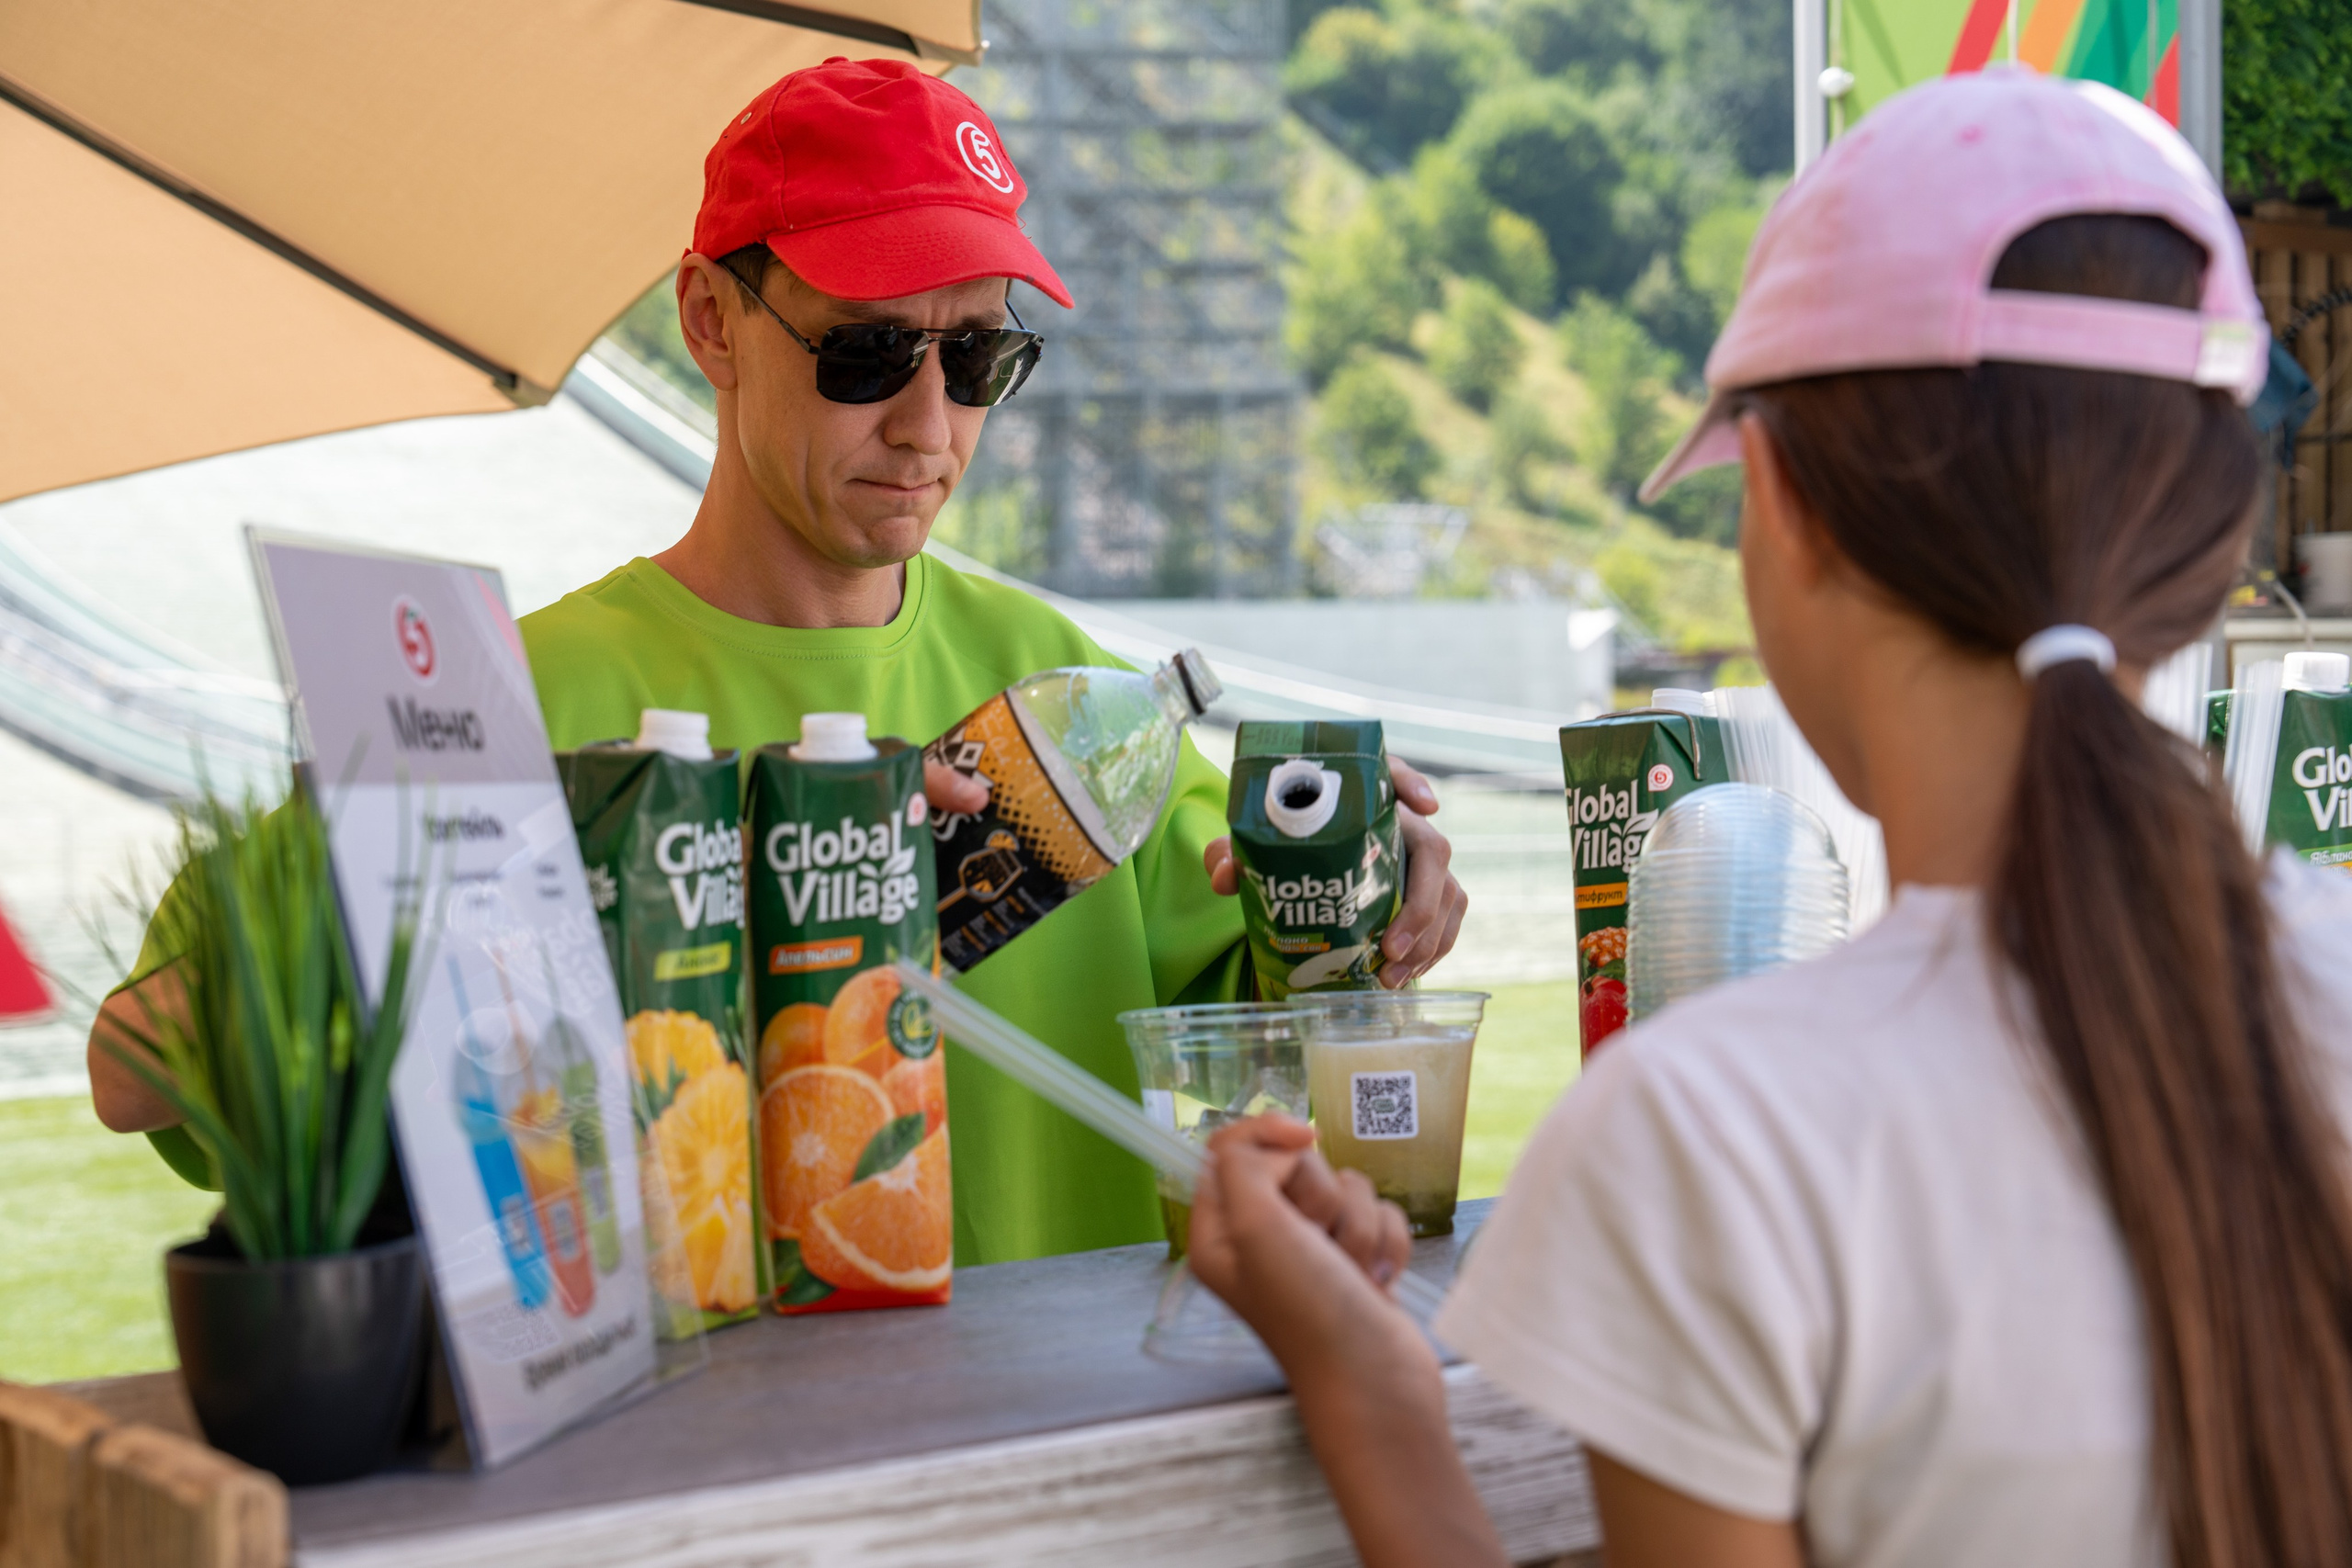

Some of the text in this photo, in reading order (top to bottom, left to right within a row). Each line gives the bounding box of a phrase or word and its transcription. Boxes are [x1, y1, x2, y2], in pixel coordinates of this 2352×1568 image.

[2291, 743, 2352, 788] Glo
[2303, 786, 2352, 831] Vil
[655, 818, 742, 876] Globa
[766, 812, 902, 872] Global
[778, 862, 919, 927] Village
[1575, 888, 1623, 904] тифрукт
